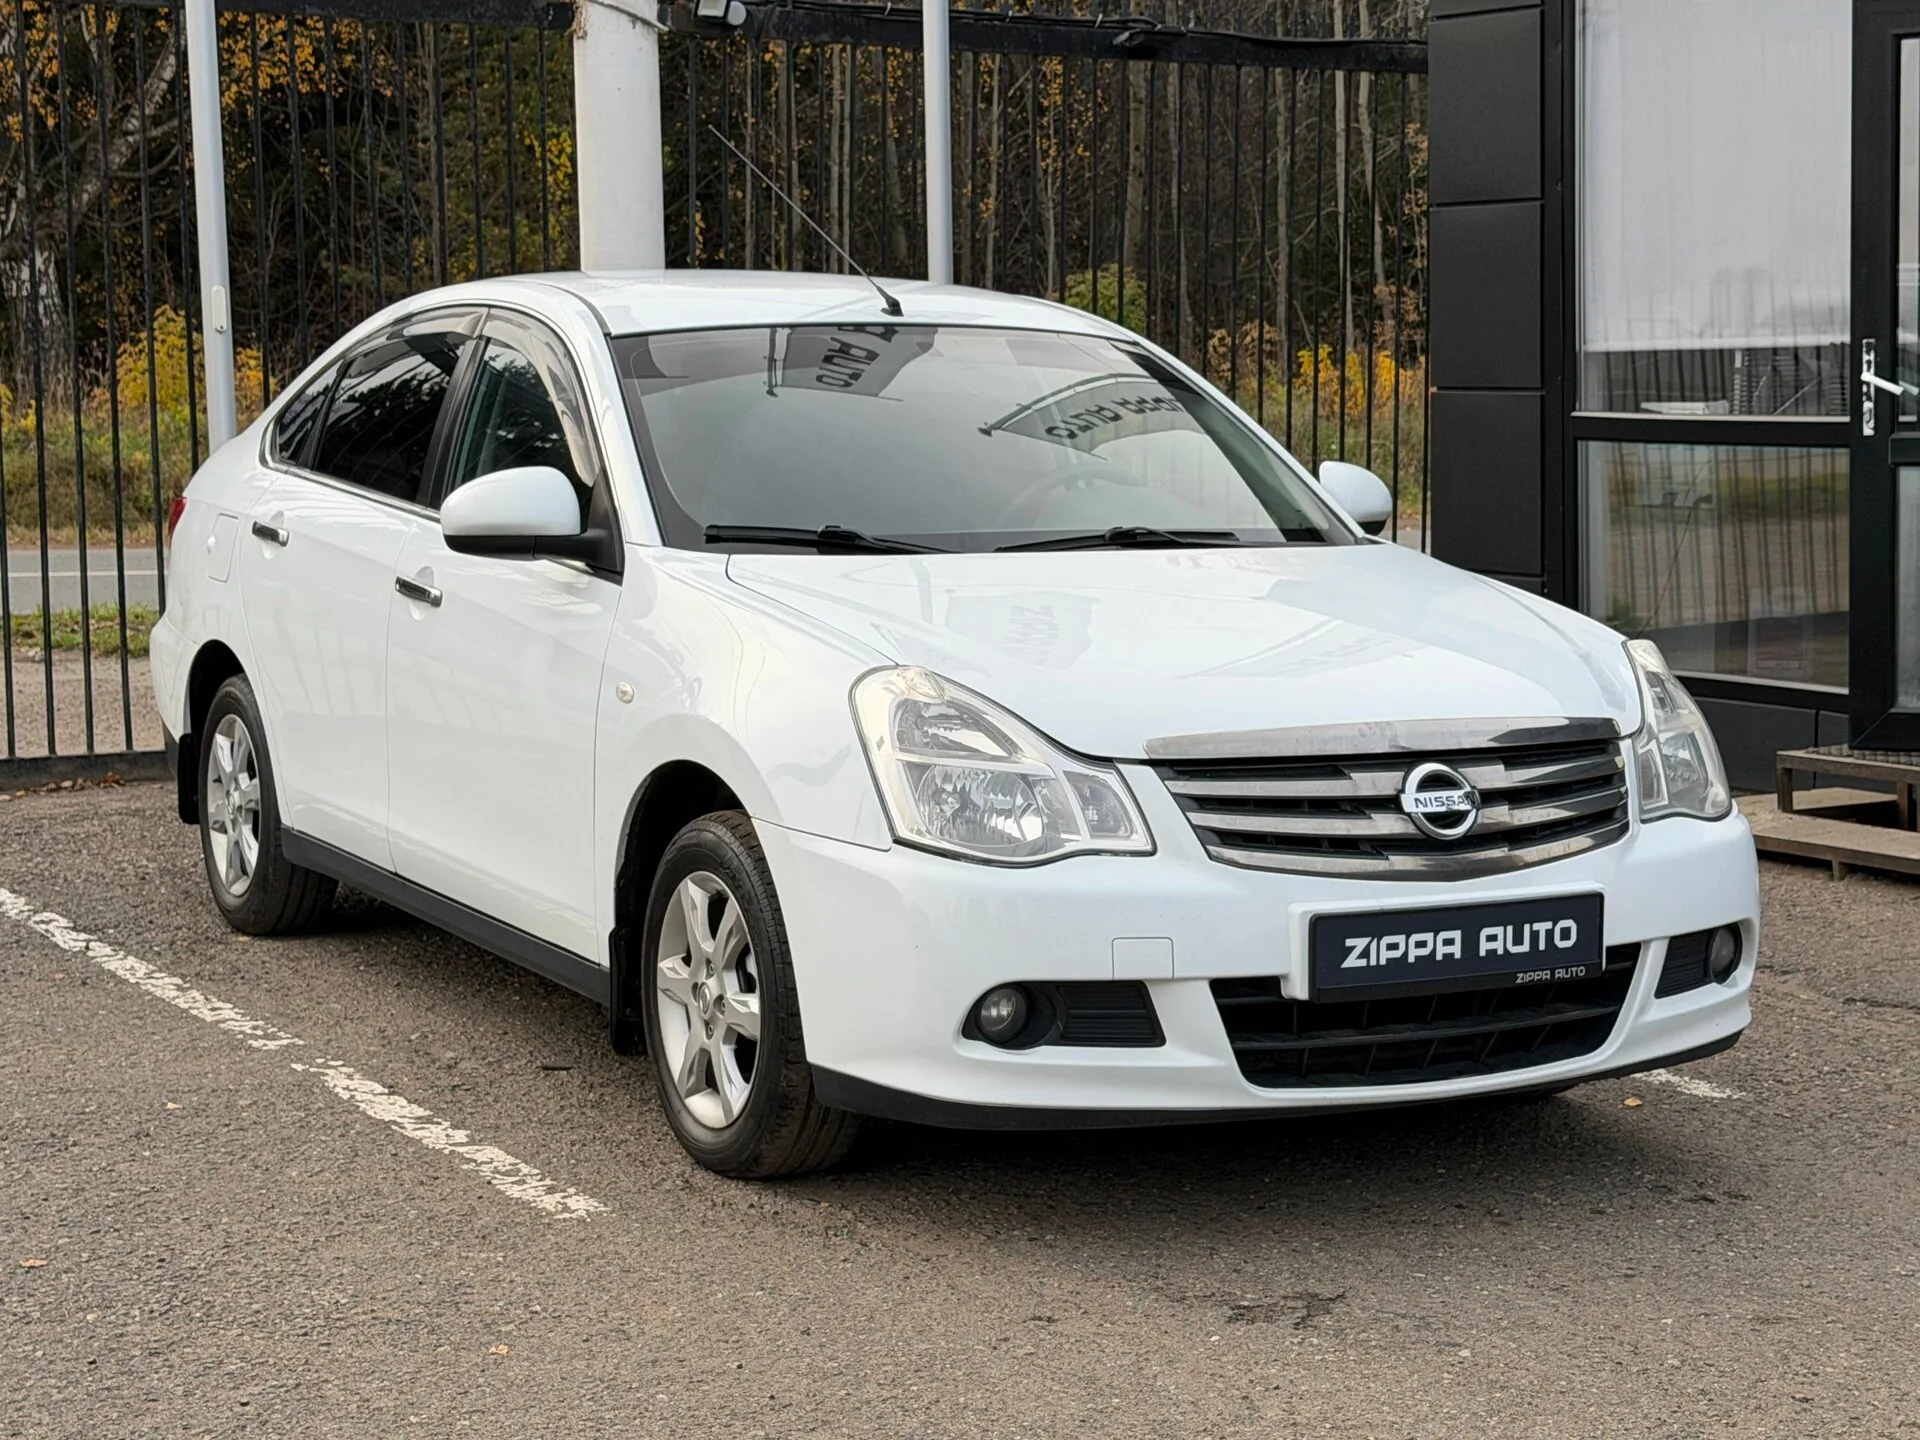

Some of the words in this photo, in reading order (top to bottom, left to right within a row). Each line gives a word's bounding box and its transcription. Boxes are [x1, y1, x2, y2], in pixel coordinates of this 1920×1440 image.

[816, 337, 880, 387] AUTO
[1045, 404, 1123, 439] AUTO
[1413, 790, 1478, 809] NISSAN
[1340, 929, 1462, 968] ZIPPA
[1479, 919, 1577, 957] AUTO
[1515, 970, 1551, 984] ZIPPA
[1554, 966, 1586, 980] AUTO
